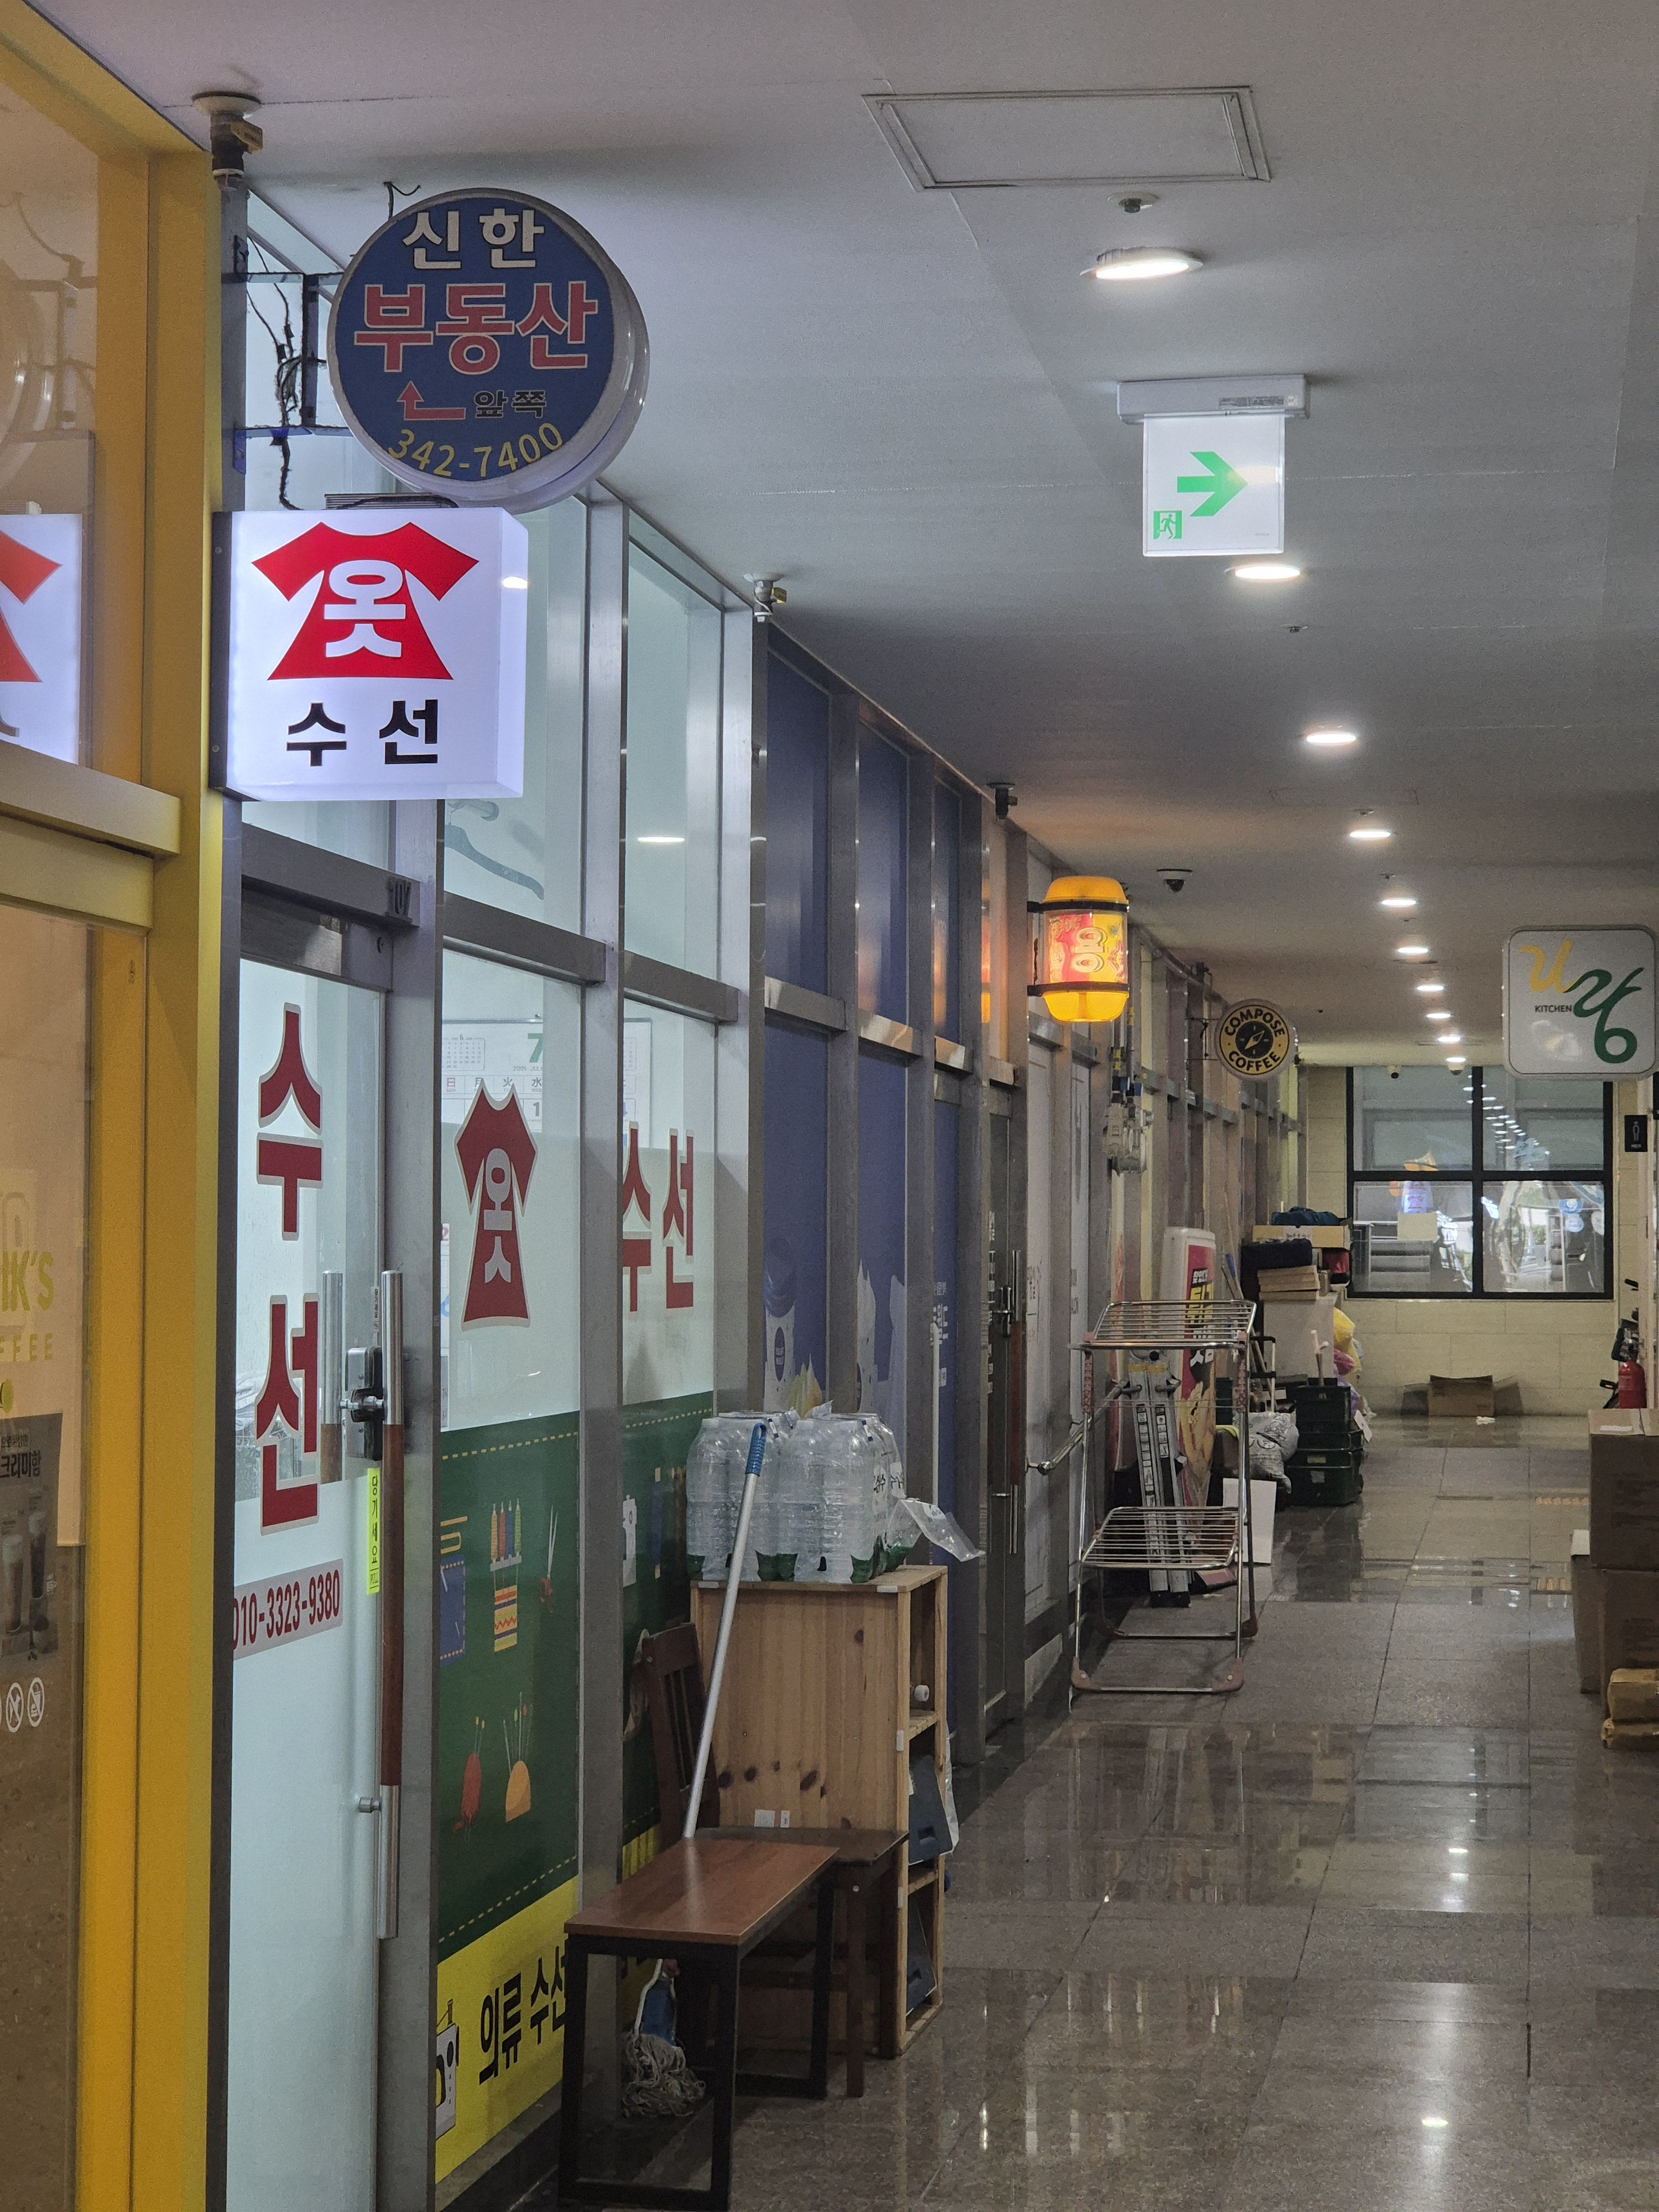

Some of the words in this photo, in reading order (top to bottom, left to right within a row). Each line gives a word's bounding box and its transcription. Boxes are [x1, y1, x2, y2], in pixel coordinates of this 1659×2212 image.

[402, 208, 545, 270] 신한
[354, 280, 598, 375] 부동산
[474, 389, 546, 419] 앞쪽
[388, 422, 563, 478] 342-7400
[324, 560, 406, 658] 옷
[285, 699, 439, 768] 수선
[1224, 1008, 1286, 1038] COMPOSE
[1535, 1004, 1572, 1013] KITCHEN
[528, 1032, 543, 1063] 7
[1228, 1050, 1281, 1072] COFFEE
[533, 1102, 540, 1117] 1
[483, 1147, 512, 1284] 옷
[256, 1002, 322, 1536] 수선
[232, 1569, 340, 1650] 010-3323-9380
